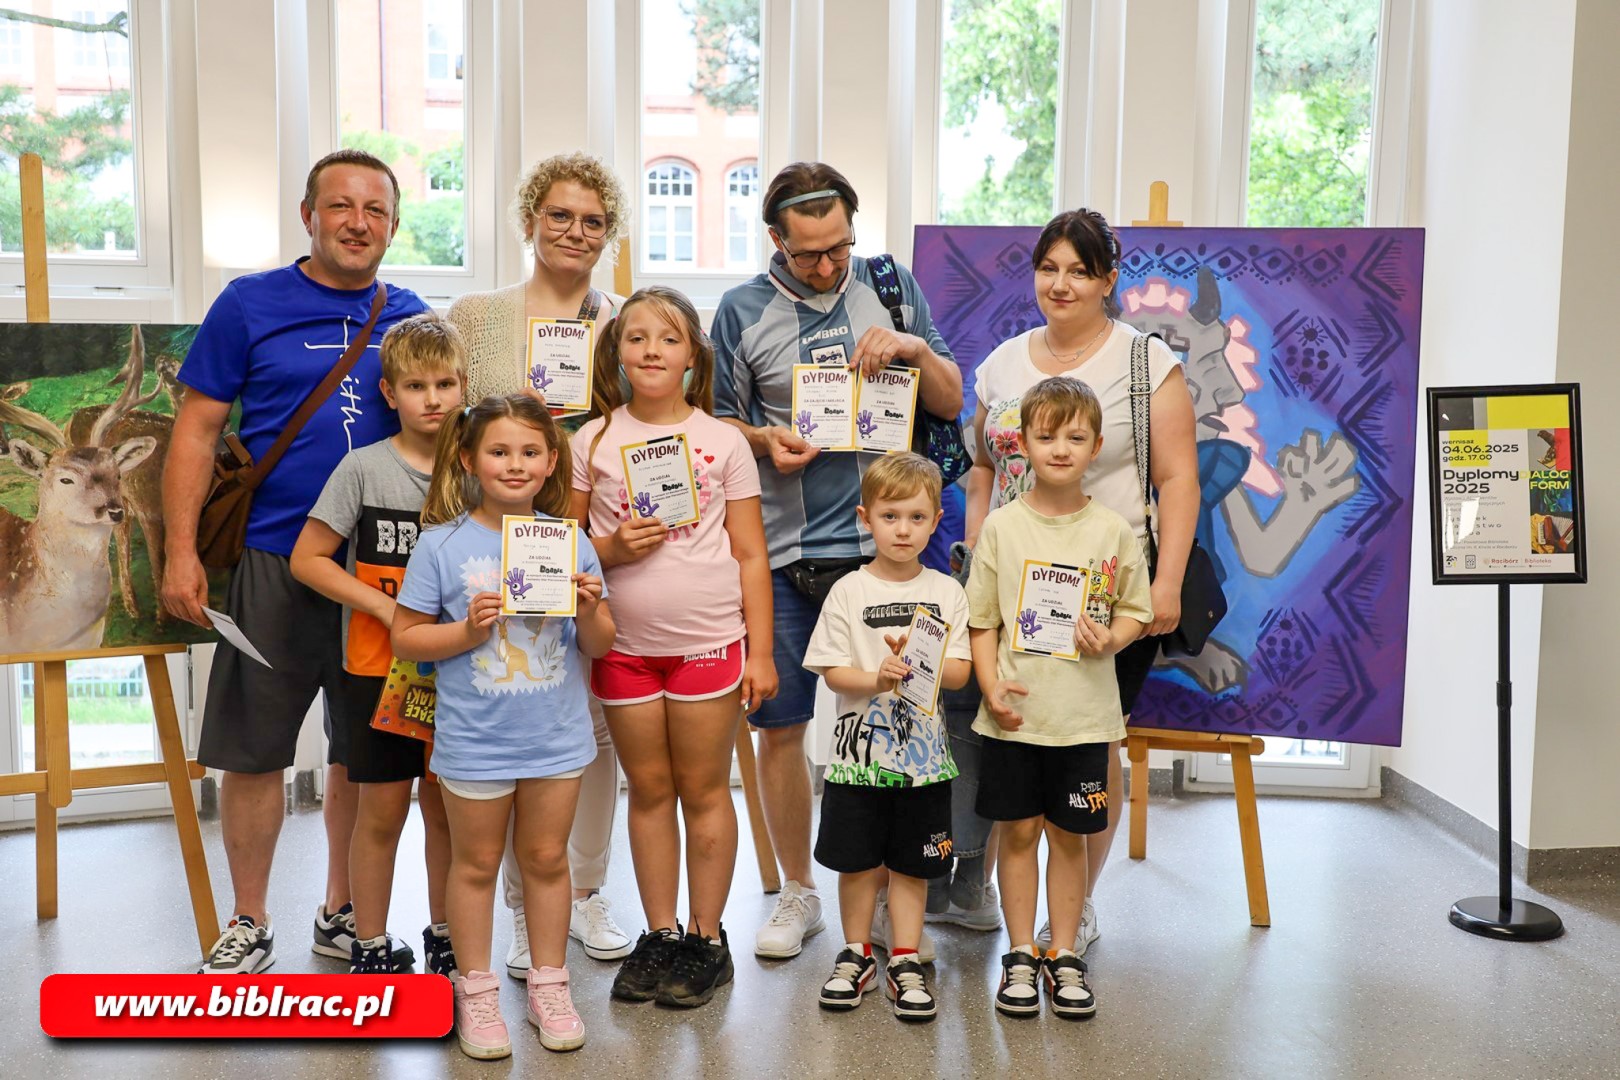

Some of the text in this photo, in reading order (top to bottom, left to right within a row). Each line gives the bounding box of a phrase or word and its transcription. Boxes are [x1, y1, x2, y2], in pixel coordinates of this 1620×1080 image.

[538, 325, 585, 340] DYPLOM!
[802, 325, 849, 344] UMBRO
[802, 372, 848, 384] DYPLOM!
[868, 372, 911, 388] DYPLOM!
[631, 445, 679, 464] DYPLOM!
[1442, 444, 1519, 454] 04.06.2025
[1443, 469, 1519, 482] Dyplomy
[1444, 483, 1490, 494] 2025
[1530, 481, 1569, 490] FORM
[515, 523, 567, 540] DYPLOM!
[1032, 568, 1080, 587] DYPLOM!
[916, 617, 945, 642] DYPLOM!
